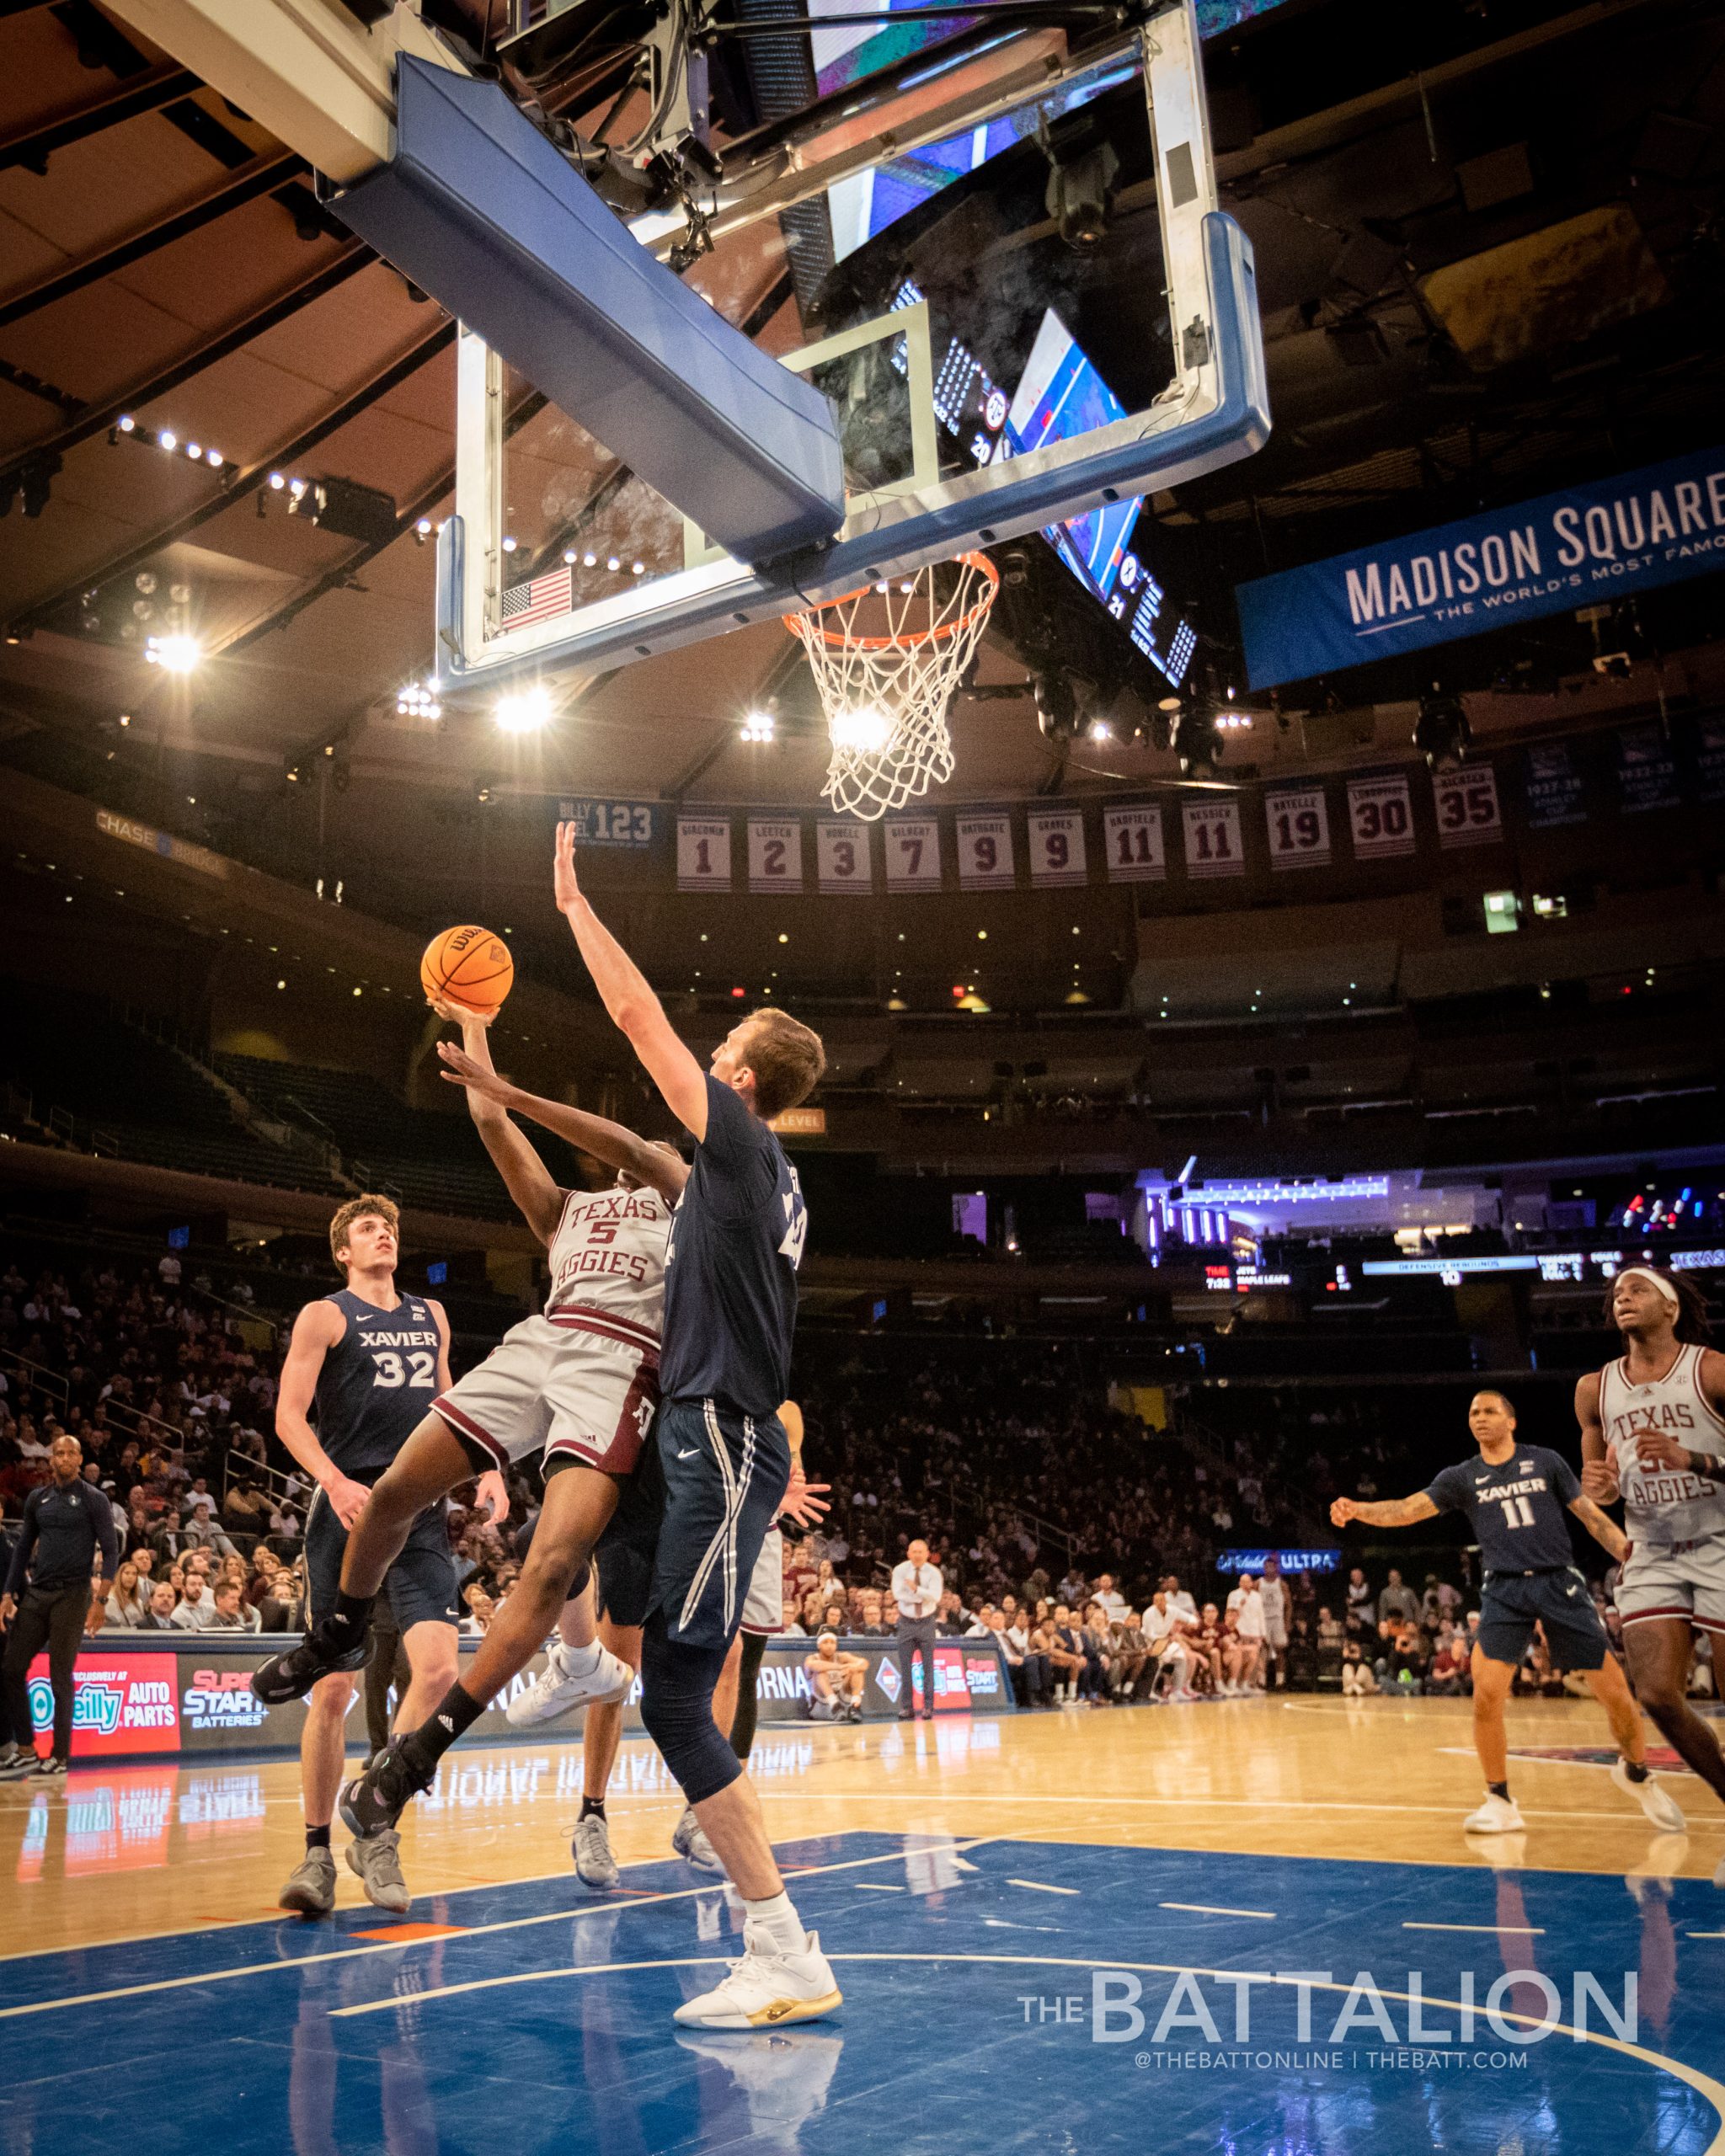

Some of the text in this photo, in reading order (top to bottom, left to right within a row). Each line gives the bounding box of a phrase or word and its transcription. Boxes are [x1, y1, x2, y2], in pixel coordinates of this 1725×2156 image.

[970, 433, 992, 464] 20
[1345, 472, 1725, 625] MADISON SQUARE
[1434, 602, 1476, 622] THE
[1482, 574, 1583, 608] WORLD'S
[1591, 554, 1655, 582] MOST
[1108, 594, 1127, 620] 21
[595, 804, 652, 841] 123
[1355, 798, 1408, 840] 30
[1439, 785, 1495, 828] 35
[96, 810, 154, 846] CHASE
[1194, 821, 1232, 861] 11
[1276, 810, 1321, 851] 19
[696, 839, 713, 874] 1
[763, 840, 787, 876] 2
[832, 841, 857, 877] 3
[900, 839, 924, 875] 7
[974, 835, 997, 873] 9
[1045, 832, 1070, 870] 9
[1117, 827, 1154, 866] 11
[781, 1115, 820, 1127] LEVEL
[571, 1196, 658, 1230] TEXAS
[587, 1221, 620, 1244] 5
[556, 1250, 649, 1289] AGGIES
[1439, 1270, 1462, 1286] 10
[359, 1331, 438, 1348] XAVIER
[371, 1351, 435, 1388] 32
[1613, 1403, 1696, 1441] TEXAS
[1476, 1478, 1547, 1503] XAVIER
[1632, 1475, 1717, 1505] AGGIES
[1500, 1497, 1536, 1529] 11
[1280, 1554, 1336, 1569] ULTRA
[72, 1671, 115, 1683] XCLUSIVELY
[128, 1682, 170, 1705] AUTO
[193, 1670, 252, 1692] SUPE
[124, 1705, 175, 1727] PARTS
[191, 1715, 263, 1729] BATTERIES
